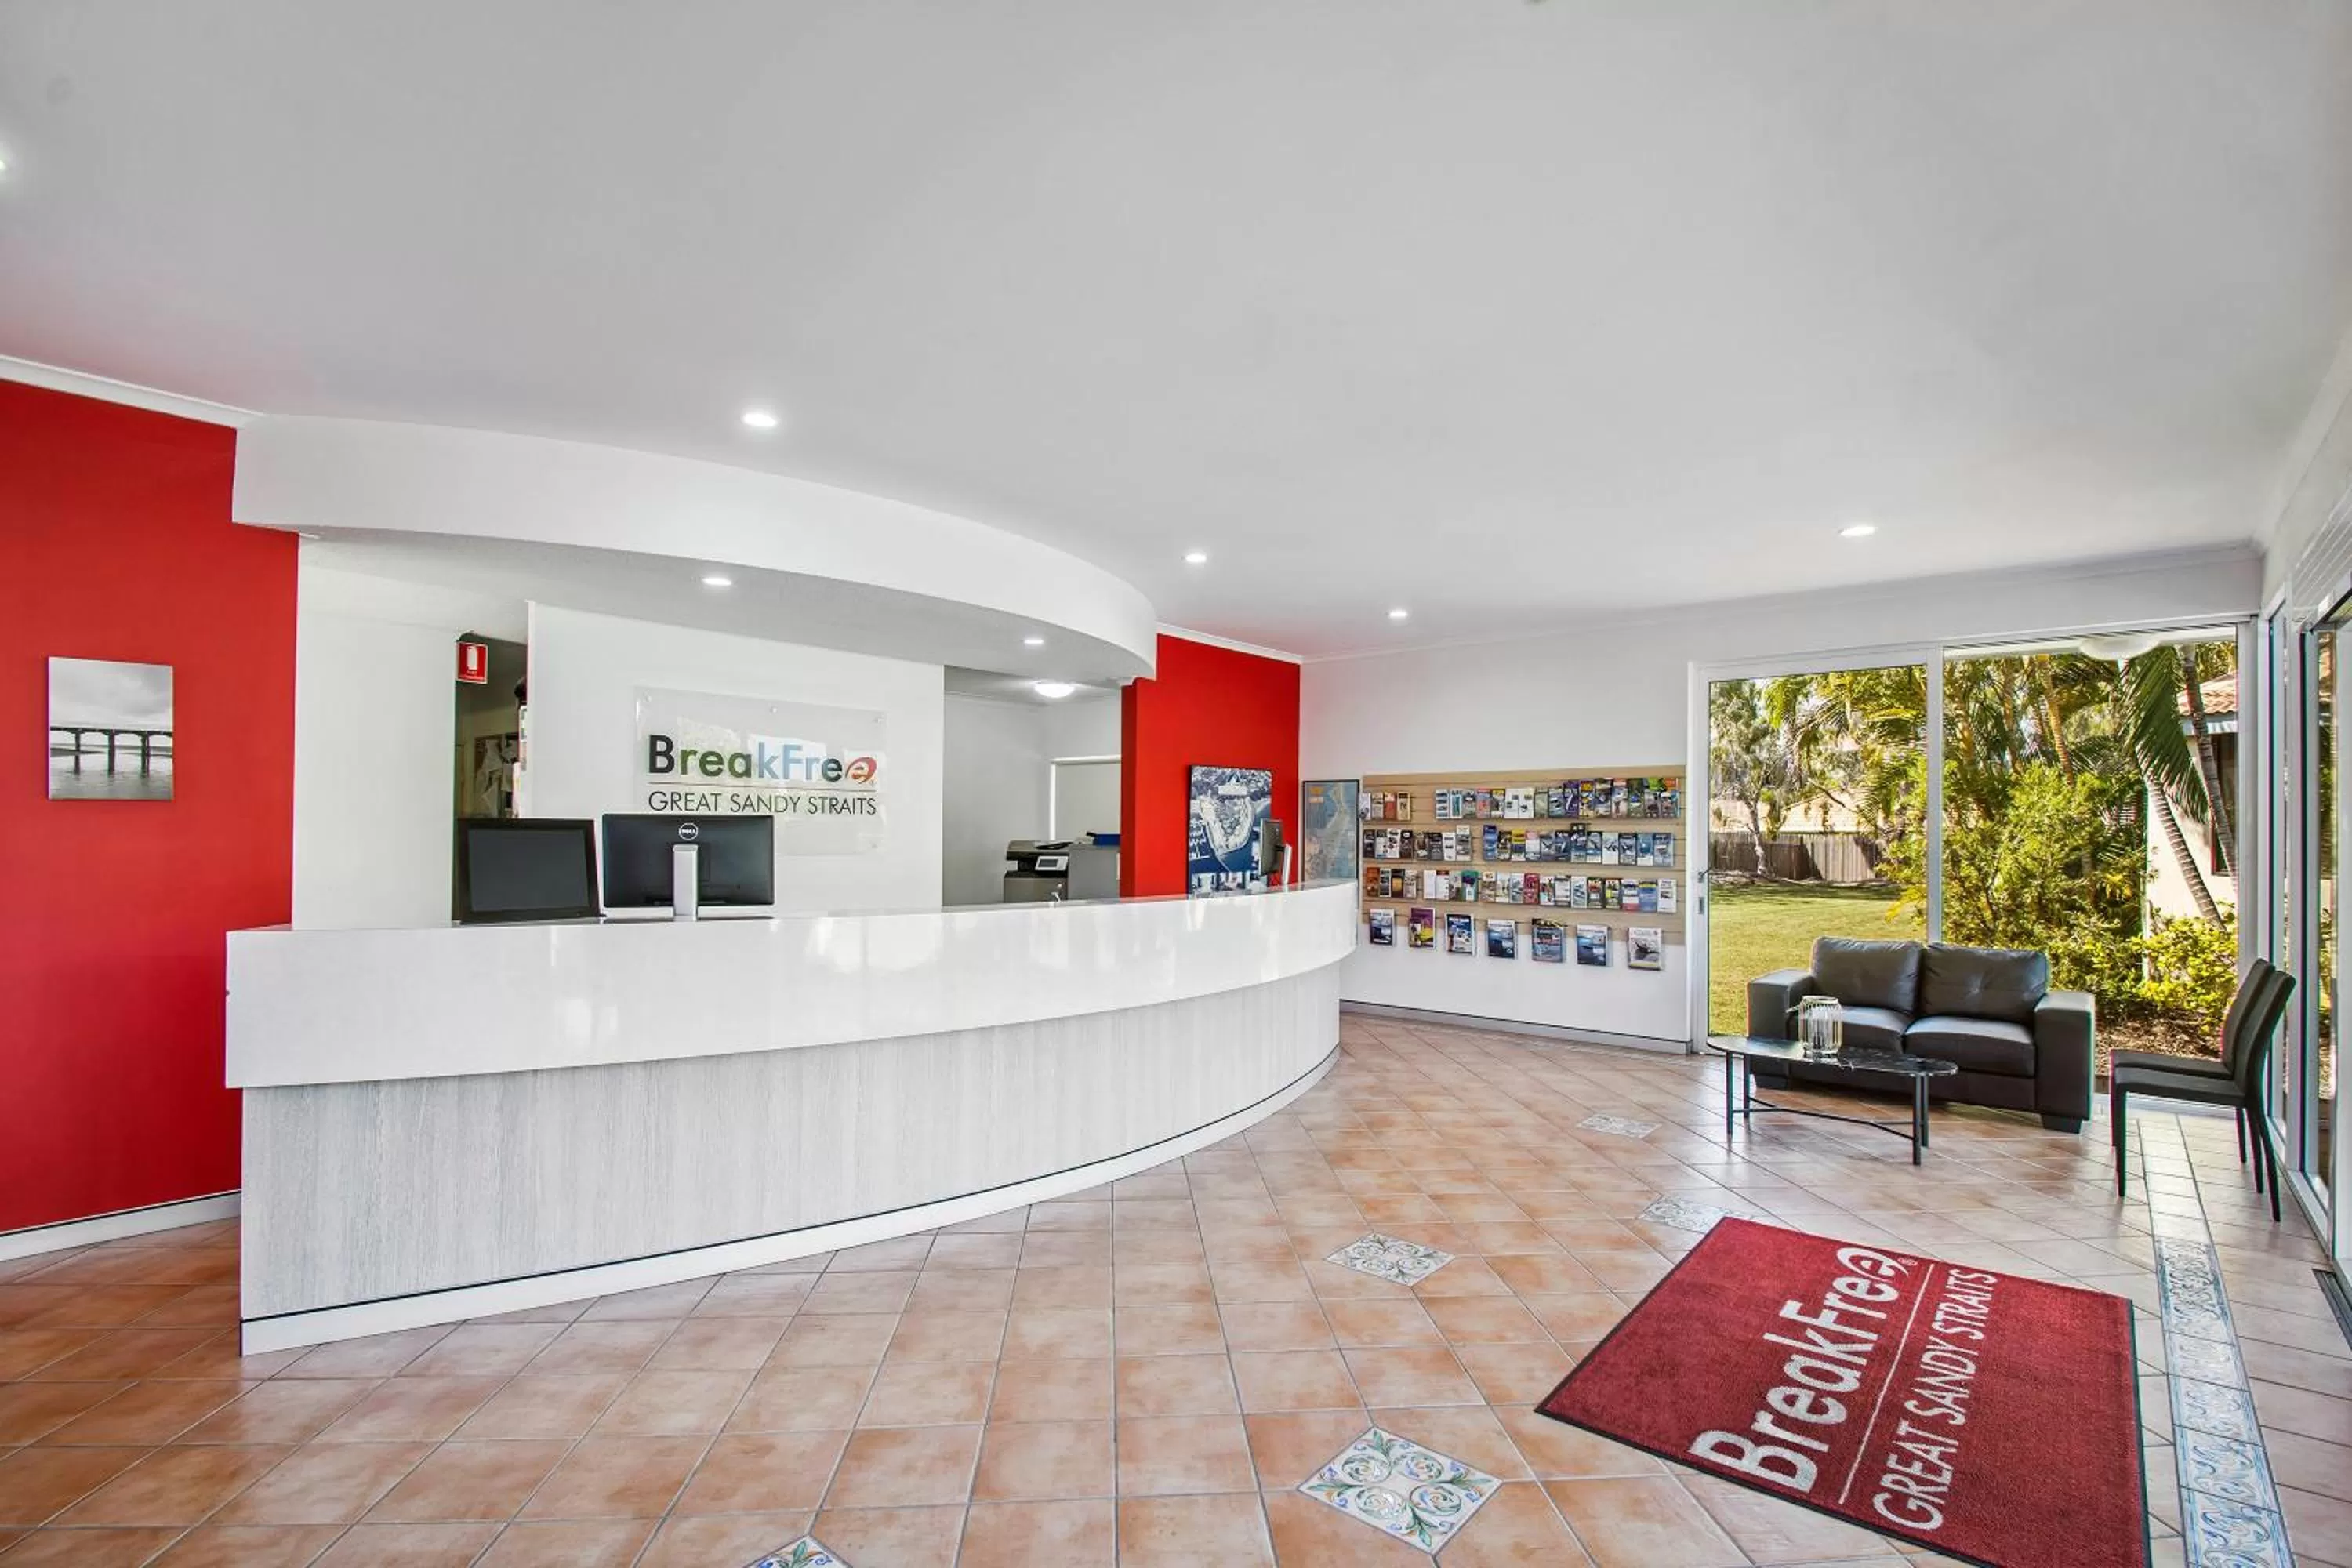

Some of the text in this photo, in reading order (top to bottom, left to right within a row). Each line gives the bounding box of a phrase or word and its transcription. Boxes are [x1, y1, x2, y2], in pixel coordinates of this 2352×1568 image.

[648, 734, 877, 784] BreakFree
[648, 791, 877, 816] GREAT SANDY STRAITS
[1686, 1247, 1909, 1494] BreakFree
[1872, 1269, 1998, 1530] GREAT SANDY STRAITS
